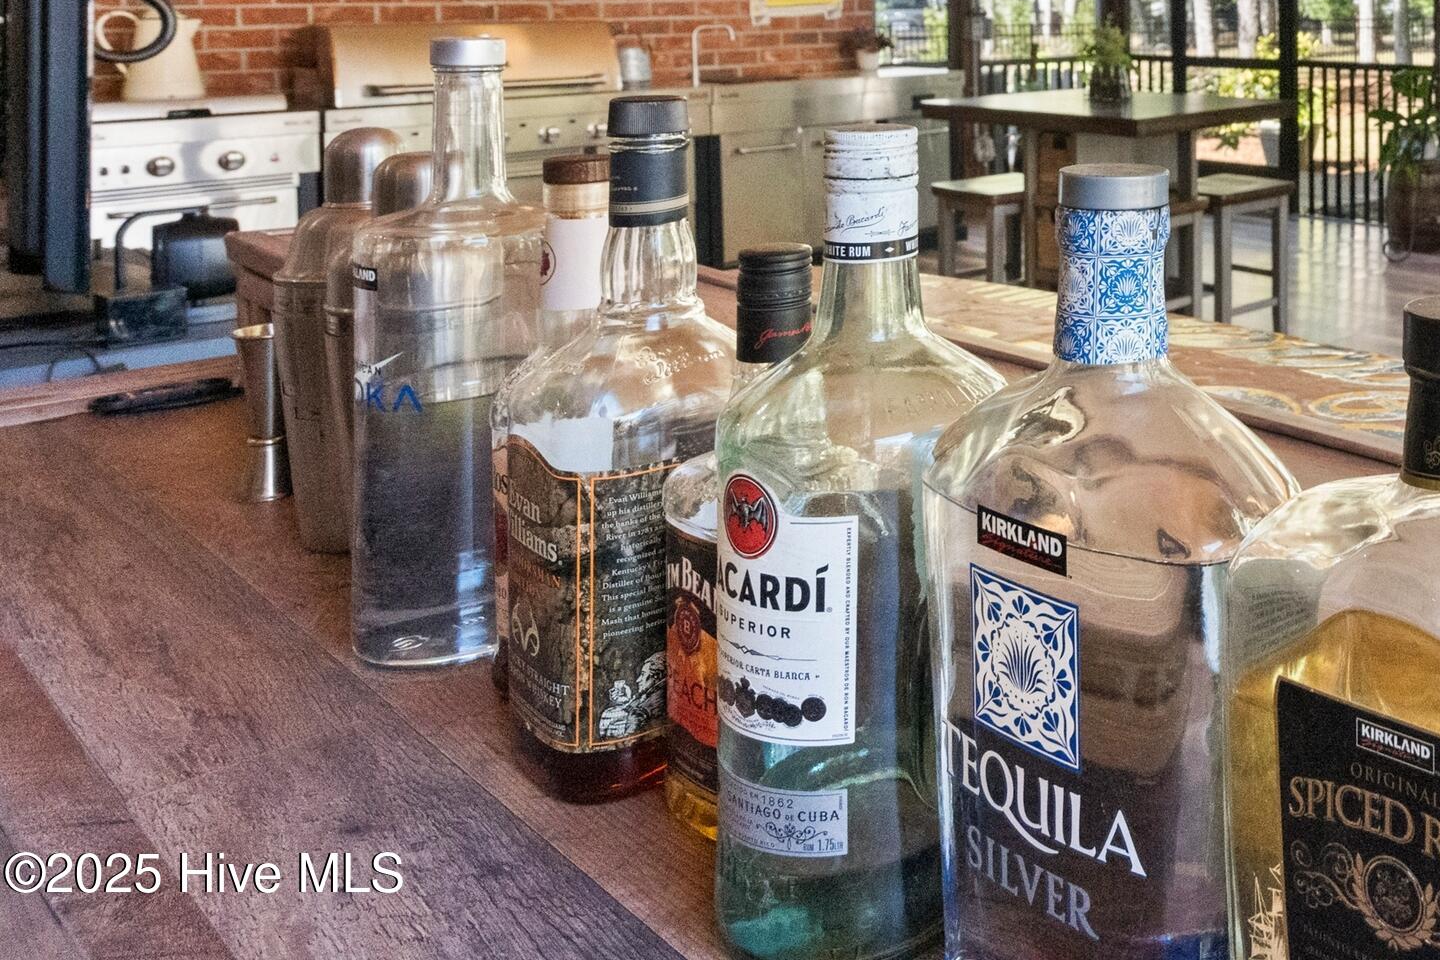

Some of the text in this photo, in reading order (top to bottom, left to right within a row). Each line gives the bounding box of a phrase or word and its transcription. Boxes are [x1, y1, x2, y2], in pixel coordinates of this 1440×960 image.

[825, 243, 871, 257] HITE RUM
[608, 496, 628, 504] Evan
[606, 510, 617, 518] up
[618, 507, 631, 515] his
[601, 521, 615, 530] the
[615, 518, 638, 528] banks
[648, 511, 661, 520] the
[605, 531, 627, 541] River
[628, 530, 636, 538] in
[981, 511, 1063, 558] KIRKLAND
[616, 549, 657, 563] recognized
[665, 556, 680, 590] IM
[602, 579, 634, 590] Distiller
[635, 576, 644, 585] of
[717, 554, 829, 613] ACARDÍ
[601, 593, 619, 602] This
[620, 587, 646, 600] special
[623, 598, 653, 612] genuine
[601, 616, 623, 626] Mash
[624, 614, 640, 622] that
[719, 604, 791, 639] SUPERIOR
[602, 625, 644, 639] pioneering
[745, 663, 771, 678] CARTA
[774, 670, 811, 681] BLANCA
[1361, 723, 1431, 760] KIRKLAND
[1350, 761, 1440, 811] ORIGINAL
[762, 795, 794, 809] 1862
[941, 719, 1147, 878] TEQUILA
[797, 810, 840, 822] CUBA
[1289, 776, 1416, 845] SPICED
[967, 825, 1100, 941] SILVER
